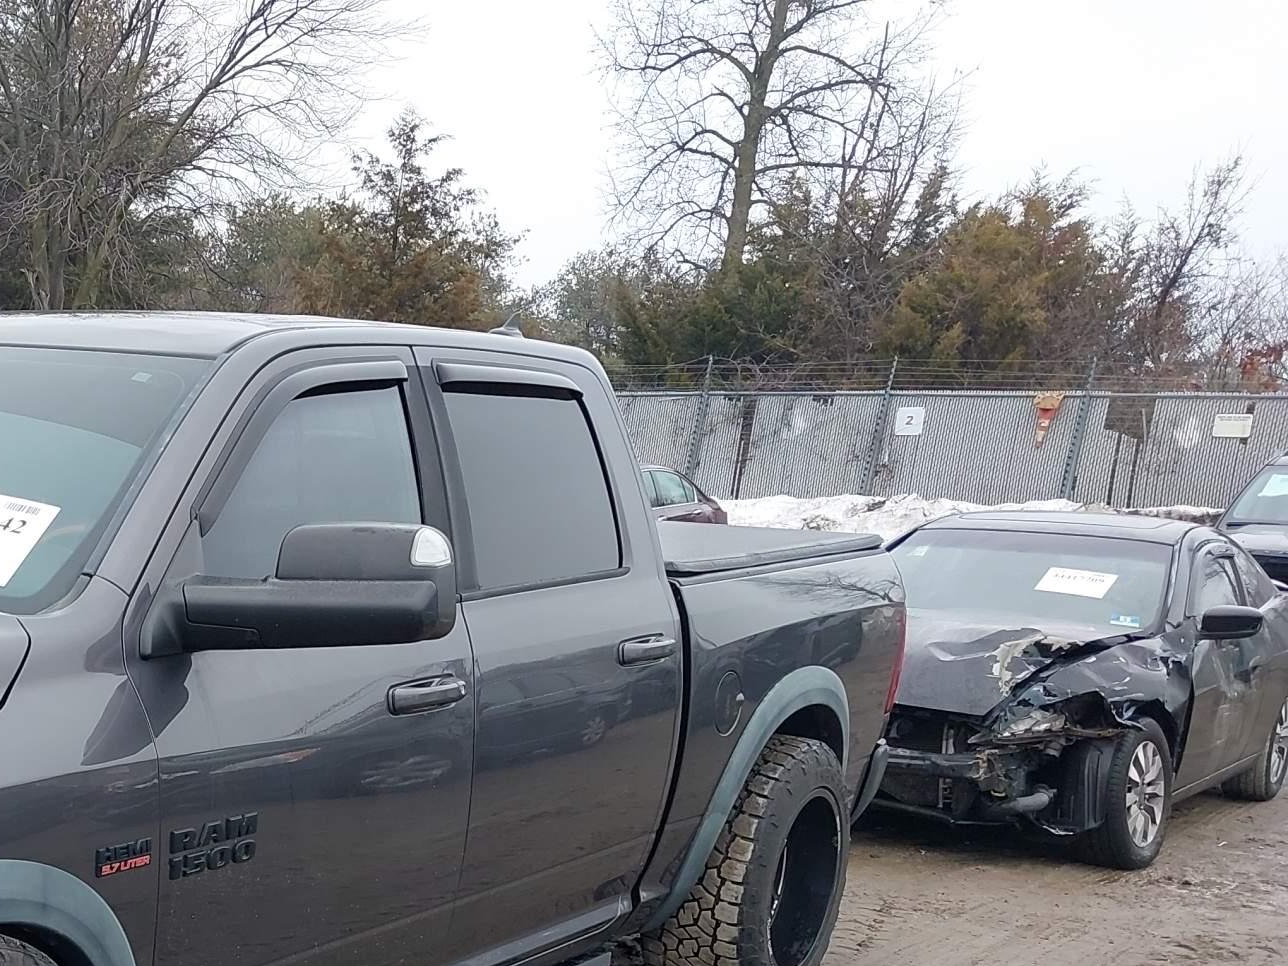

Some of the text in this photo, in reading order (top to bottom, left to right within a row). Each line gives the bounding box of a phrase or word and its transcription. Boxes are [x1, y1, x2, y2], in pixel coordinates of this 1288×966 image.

[905, 415, 914, 425] 2
[169, 811, 258, 853] RAM
[96, 837, 152, 864] HEMI
[169, 839, 257, 880] 1500
[101, 855, 151, 876] 5.7 LITER
